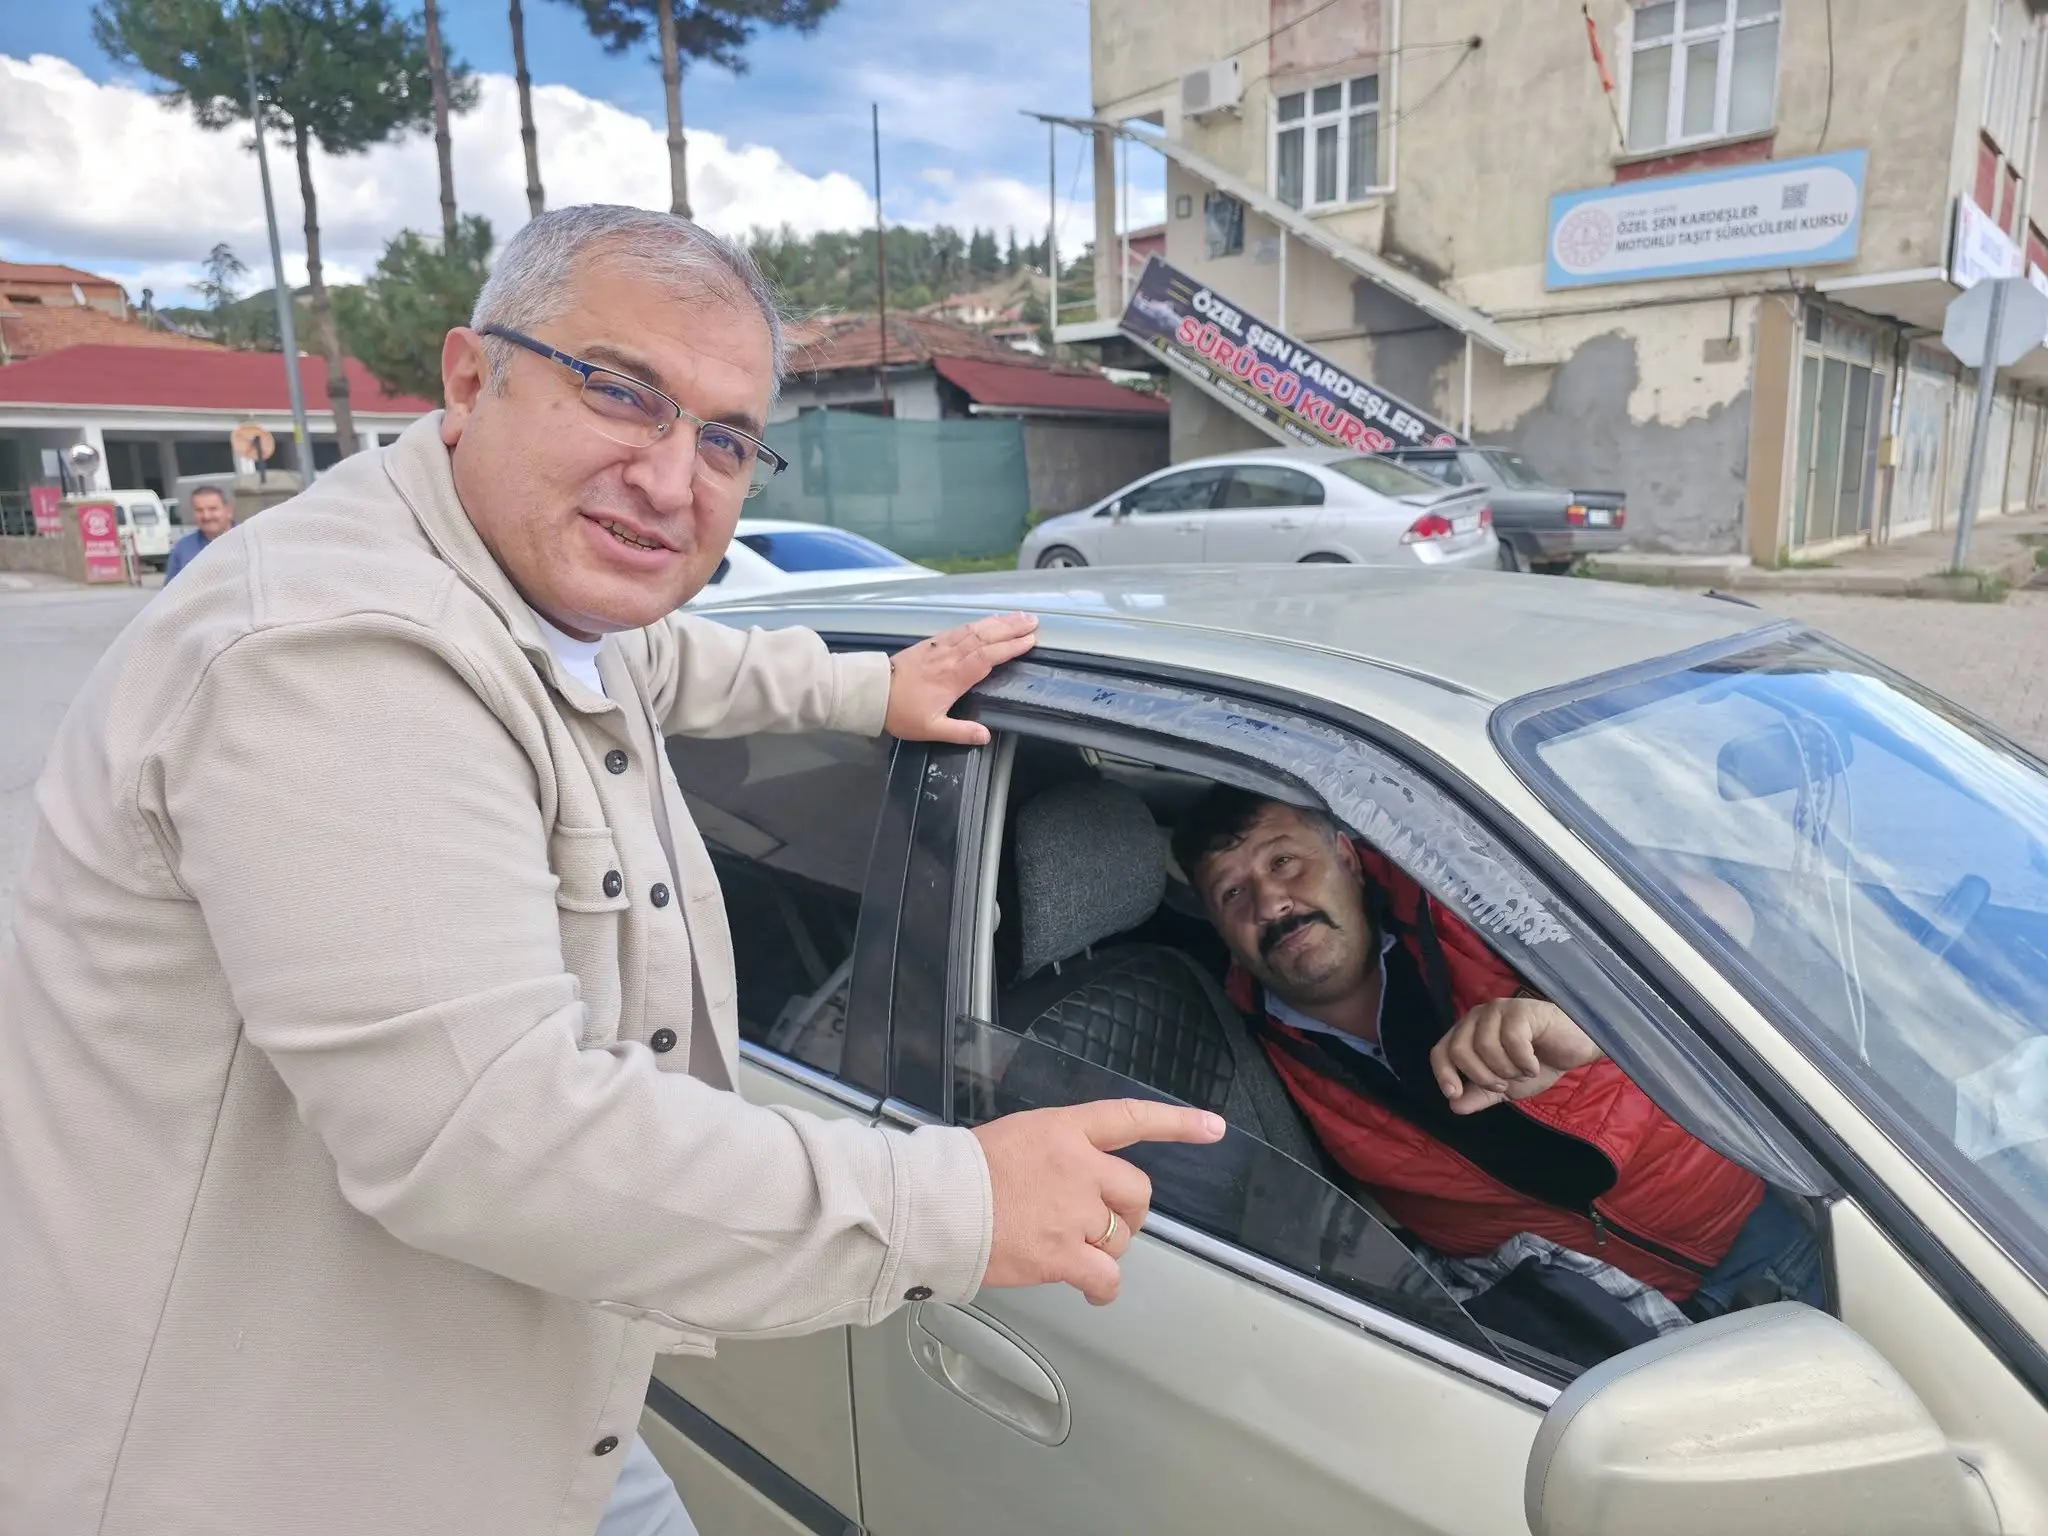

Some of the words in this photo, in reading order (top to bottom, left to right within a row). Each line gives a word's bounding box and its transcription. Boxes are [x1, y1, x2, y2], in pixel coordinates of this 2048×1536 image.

[1615, 233, 1675, 252] MOTORLU
[1678, 229, 1712, 247] TAŞIT
[1715, 214, 1798, 241] SÜRÜCÜLERİ
[1800, 211, 1849, 231] KURSU
[1616, 216, 1648, 235] ÖZEL
[1652, 215, 1677, 233] ŞEN
[1680, 204, 1759, 225] KARDEŞLER
[1176, 315, 1301, 406] SÜRÜCÜ
[1295, 388, 1396, 453] KURS
[1192, 287, 1243, 337] ÖZEL
[1246, 324, 1293, 363] ŞEN
[1290, 350, 1425, 443] KARDEŞLER
